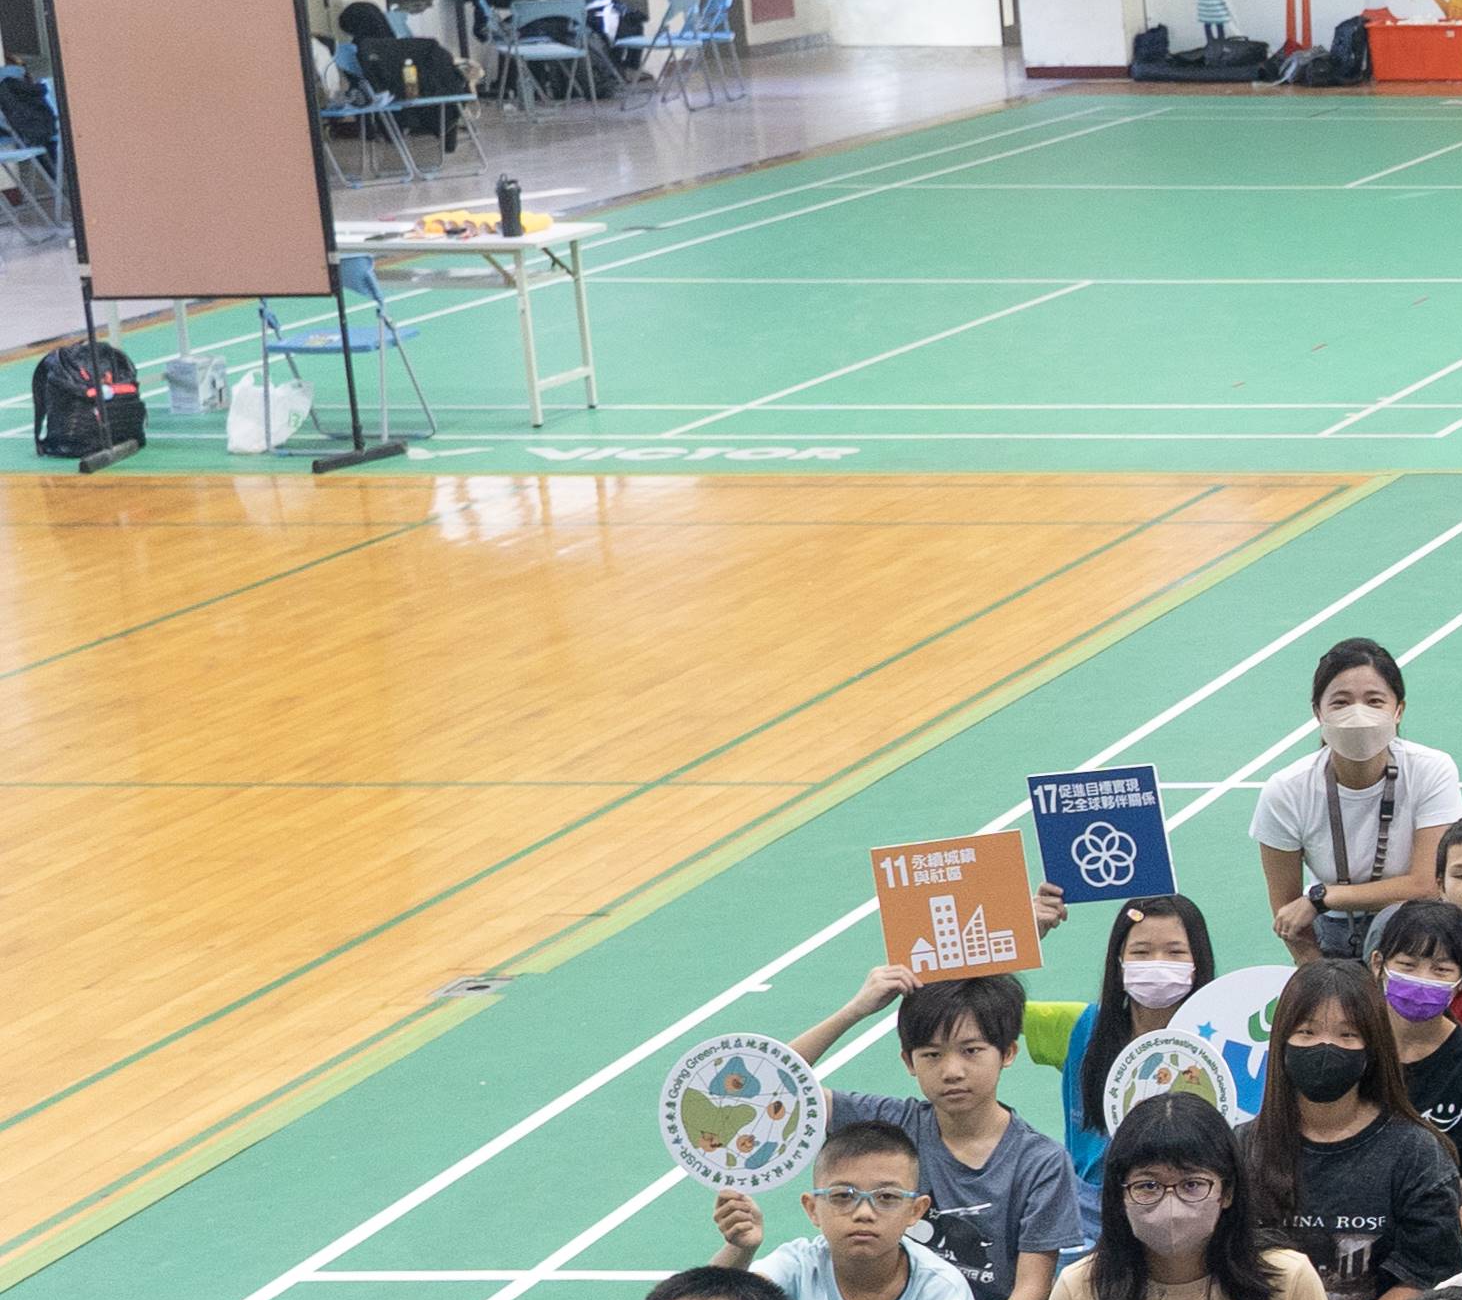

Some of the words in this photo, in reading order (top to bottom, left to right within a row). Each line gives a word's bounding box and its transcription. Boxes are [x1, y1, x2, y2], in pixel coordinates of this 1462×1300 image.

[520, 445, 862, 463] VICTOR
[1033, 784, 1060, 815] 17
[1059, 778, 1141, 799] 促進目標實現
[1061, 791, 1156, 814] 之全球夥伴關係
[911, 847, 977, 870] 永續城鎮
[880, 854, 910, 889] 11
[913, 866, 963, 887] 與社區
